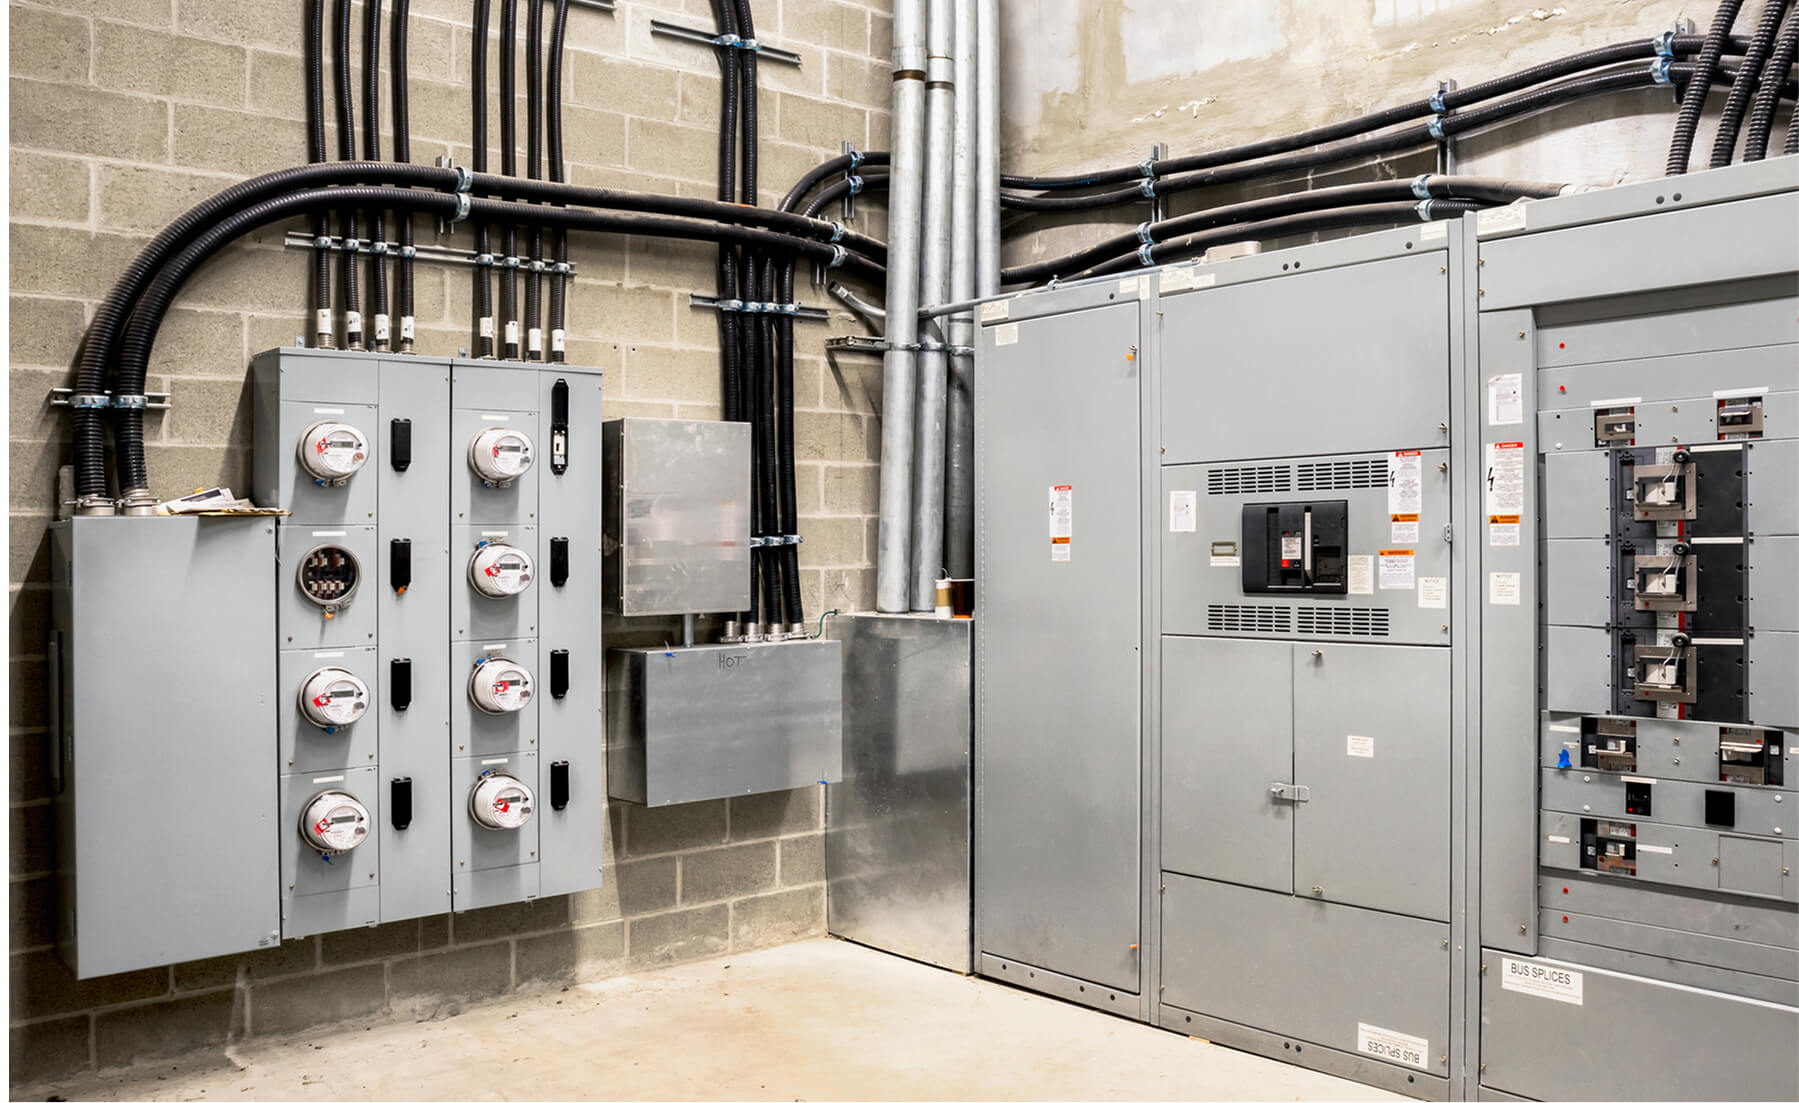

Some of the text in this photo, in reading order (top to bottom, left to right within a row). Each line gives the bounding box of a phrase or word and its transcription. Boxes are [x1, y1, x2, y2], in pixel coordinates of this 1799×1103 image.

[719, 652, 747, 669] HOT
[1511, 963, 1571, 985] BUS SPLICES
[1367, 1041, 1420, 1064] BUS SPLICES
